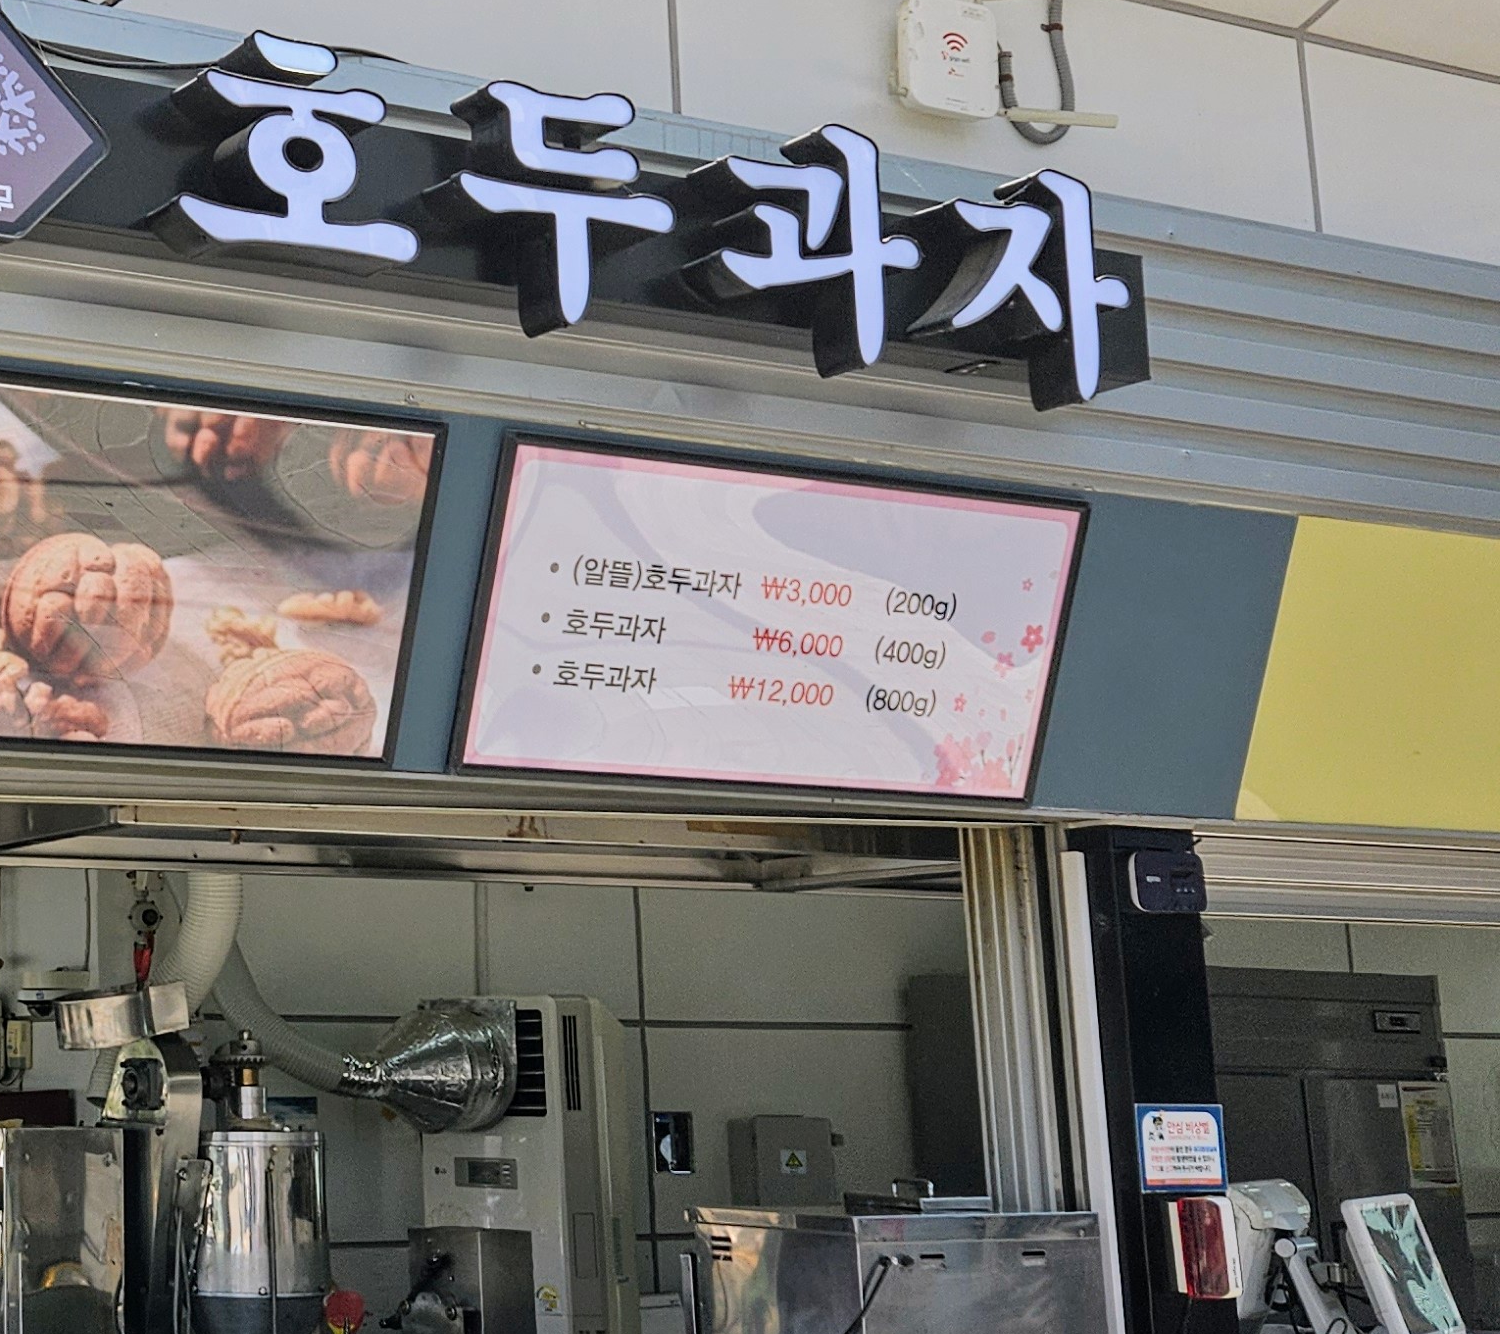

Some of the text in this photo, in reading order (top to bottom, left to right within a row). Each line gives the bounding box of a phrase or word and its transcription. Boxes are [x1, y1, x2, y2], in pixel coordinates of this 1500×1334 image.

[177, 29, 1132, 402] 호두과자
[573, 553, 958, 622] (알뜰)호두과자 ₩3,000 (200g)
[562, 608, 947, 670] 호두과자 ₩6,000 (400g)
[552, 660, 938, 718] 호두과자 ₩12,000 (800g)
